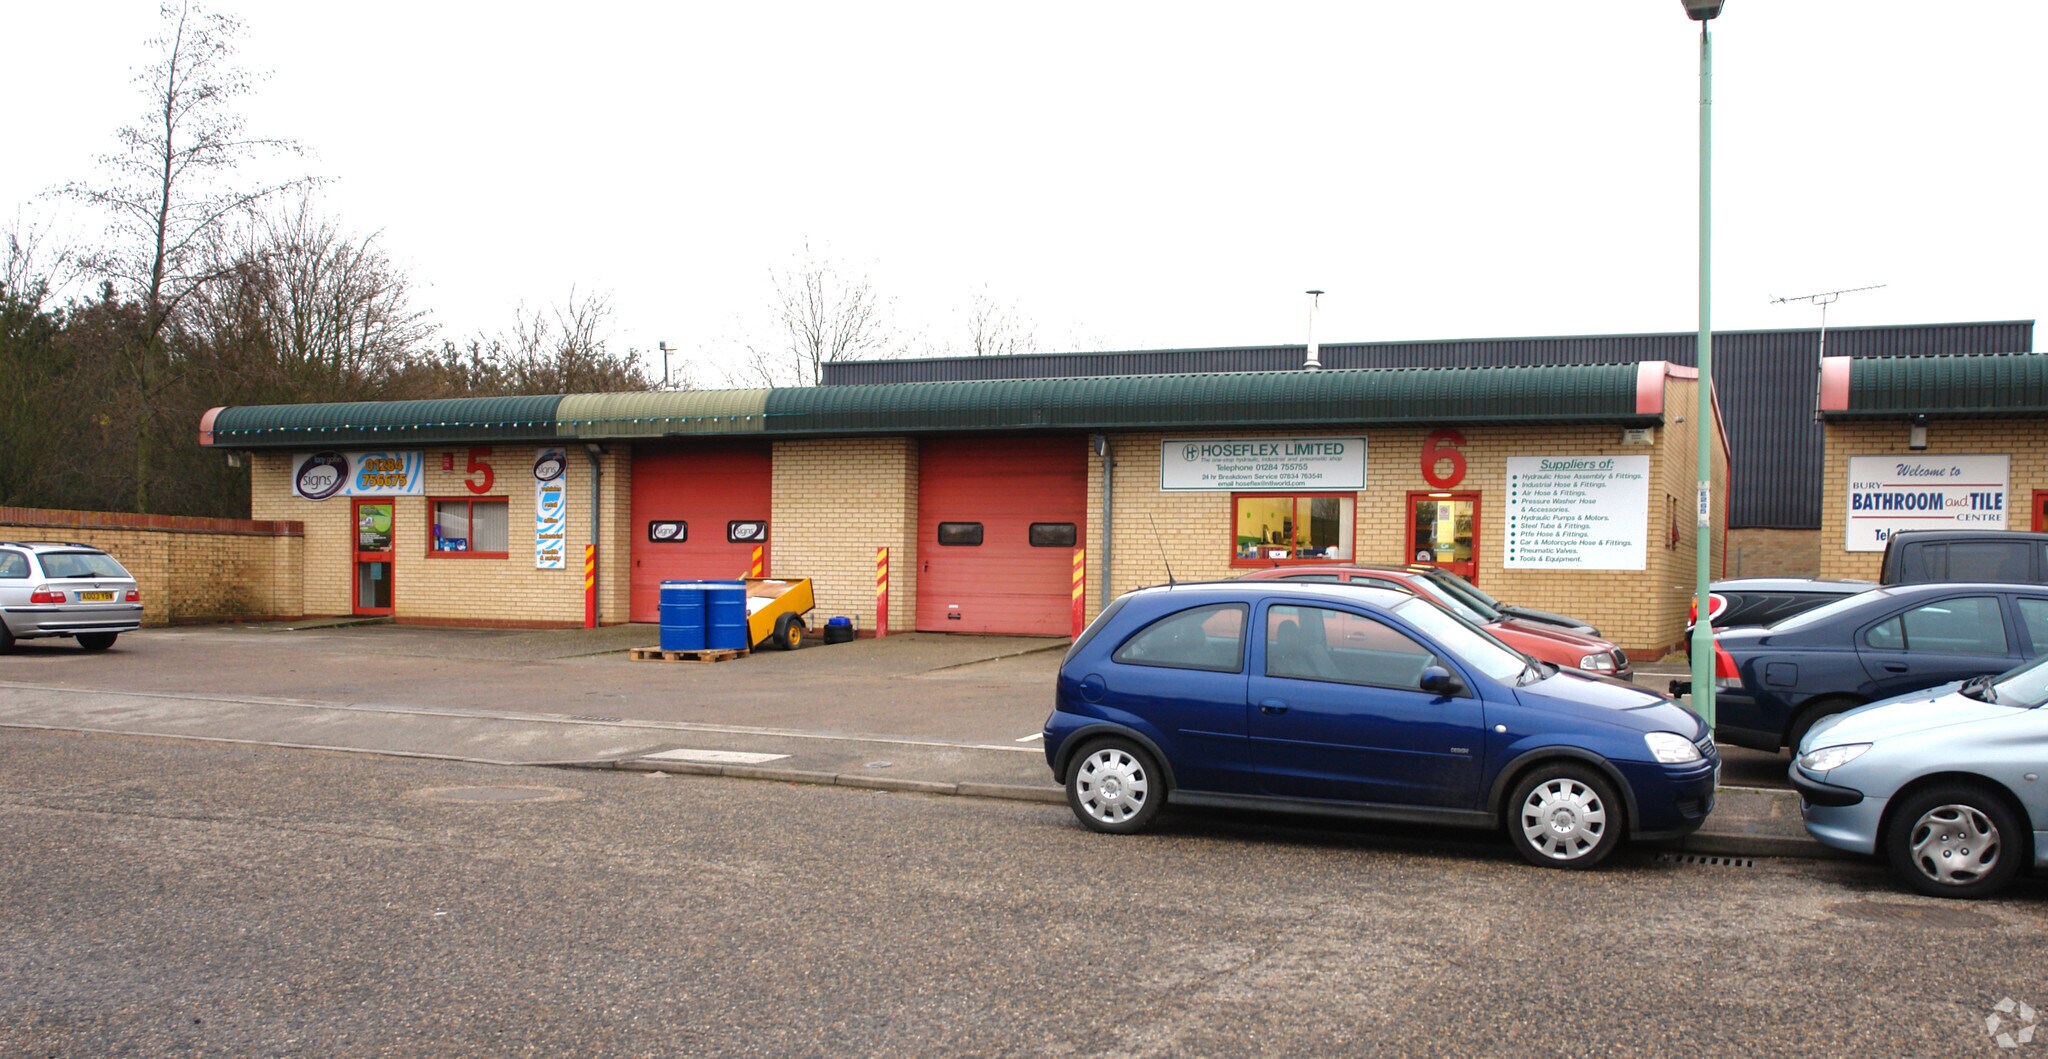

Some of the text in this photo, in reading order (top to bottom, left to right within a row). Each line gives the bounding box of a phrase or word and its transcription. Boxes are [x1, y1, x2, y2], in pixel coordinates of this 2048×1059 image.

[1201, 442, 1345, 457] HOSEFLEX LIMITED
[365, 458, 404, 472] 01284
[1421, 428, 1467, 489] 6
[1540, 458, 1615, 470] Suppliers of:
[464, 448, 494, 494] 5
[1216, 464, 1253, 472] Telephone
[1256, 463, 1278, 471] 01284
[1896, 463, 1961, 477] Welcome to
[303, 472, 332, 490] signs
[362, 474, 408, 487] 756675
[1521, 473, 1552, 481] Hydraulic
[1573, 473, 1606, 481] Assembly
[1852, 492, 2003, 510] BATHROOM and TILE
[1956, 513, 2002, 521] CENTRE
[657, 527, 674, 536] signs
[736, 527, 754, 536] signs
